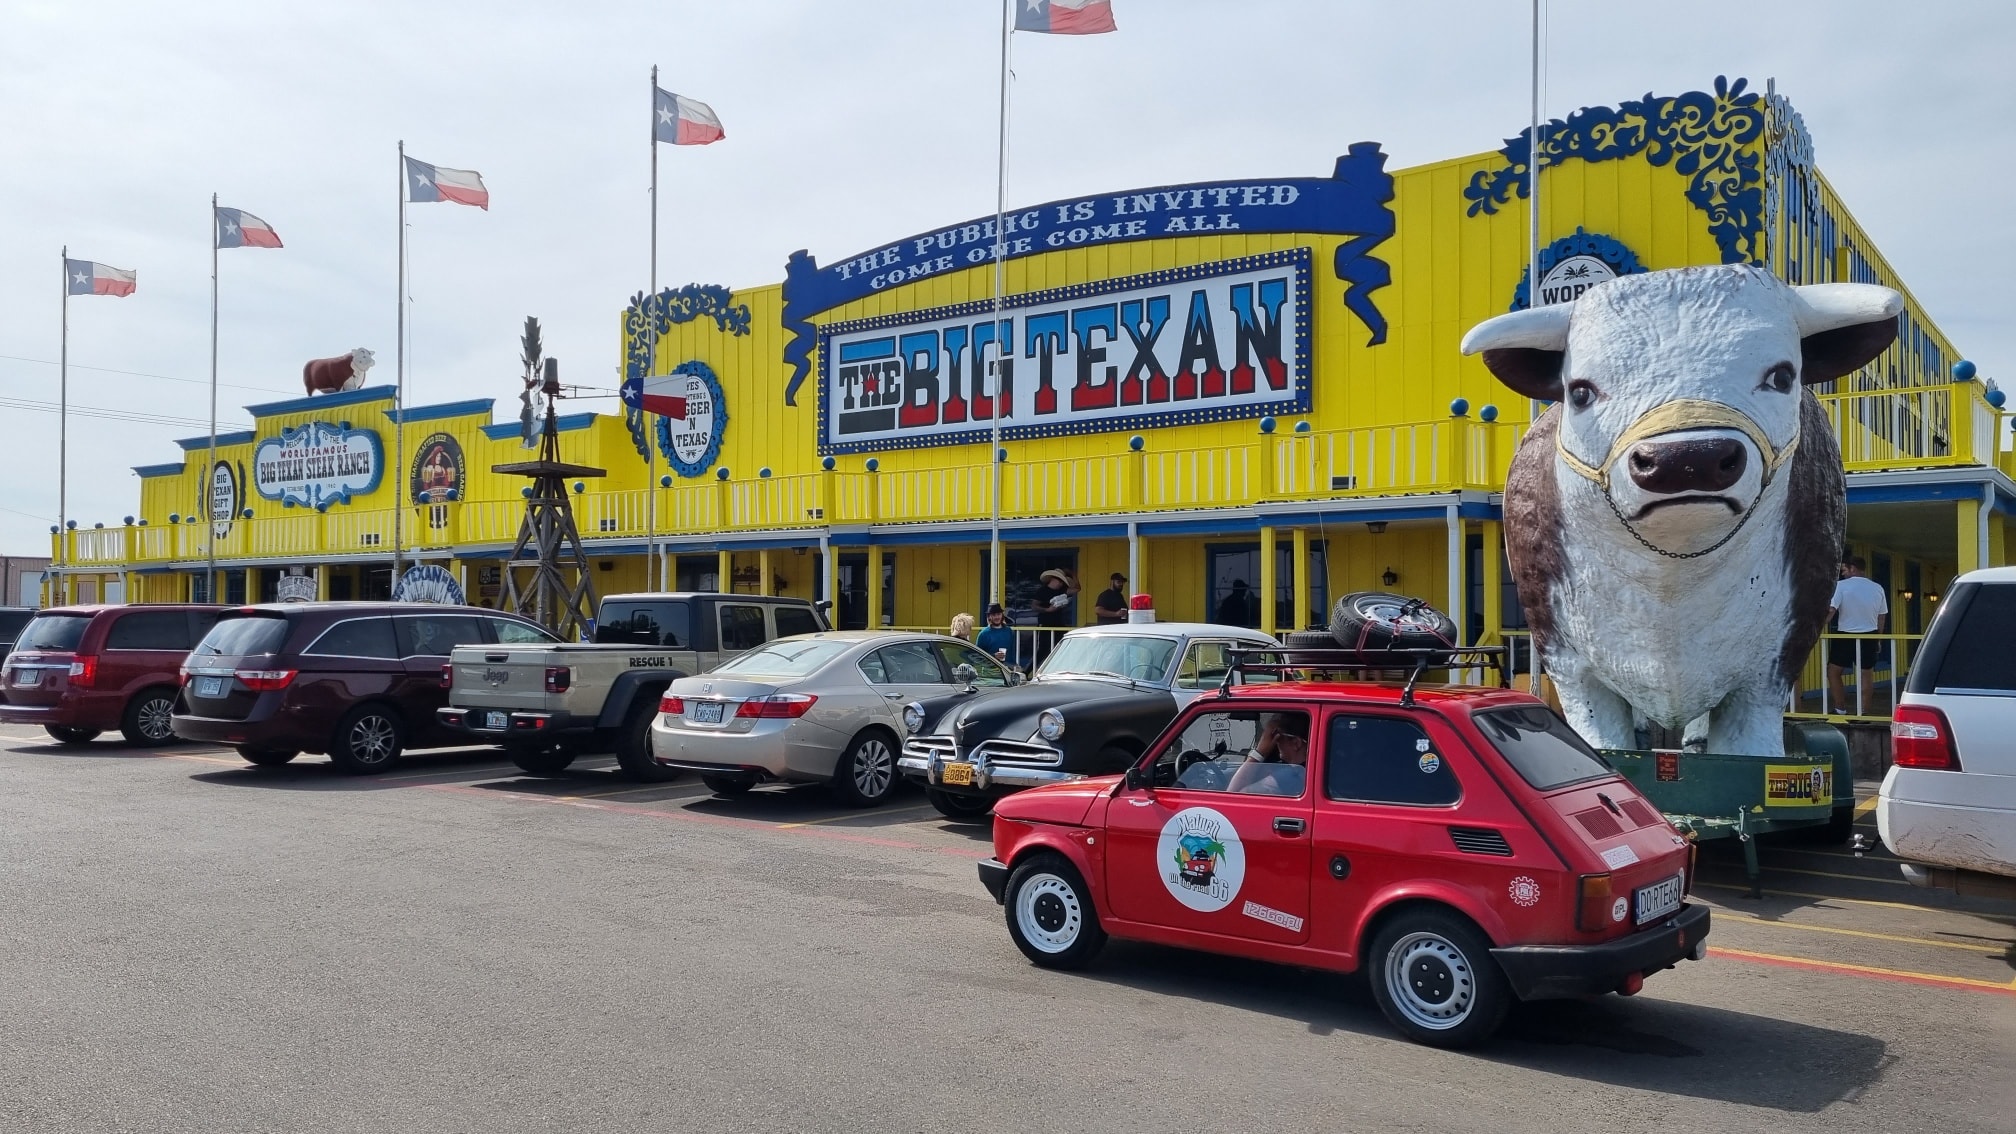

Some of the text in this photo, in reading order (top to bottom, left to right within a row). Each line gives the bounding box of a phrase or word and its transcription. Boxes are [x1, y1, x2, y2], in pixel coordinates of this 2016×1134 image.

[835, 185, 1300, 281] THE PUBLIC IS INVITED
[870, 213, 1240, 289] COME ONE COME ALL
[1542, 282, 1596, 305] WOR
[839, 277, 1288, 429] THE BIG TEXAN
[685, 401, 710, 416] GGER
[286, 432, 341, 449] WELCOME TO THE
[675, 432, 708, 448] TEXAS
[280, 444, 348, 459] WORLD FAMOUS
[260, 450, 370, 485] BIG TEXAN STEAK RANCH
[216, 473, 227, 484] BIG
[213, 485, 232, 497] EXAN
[214, 498, 229, 509] GIFT
[213, 510, 230, 521] SHOP
[629, 657, 673, 668] RESCUE 1
[483, 668, 508, 684] Jeep
[1176, 814, 1221, 839] Maluch
[1210, 875, 1229, 902] 66
